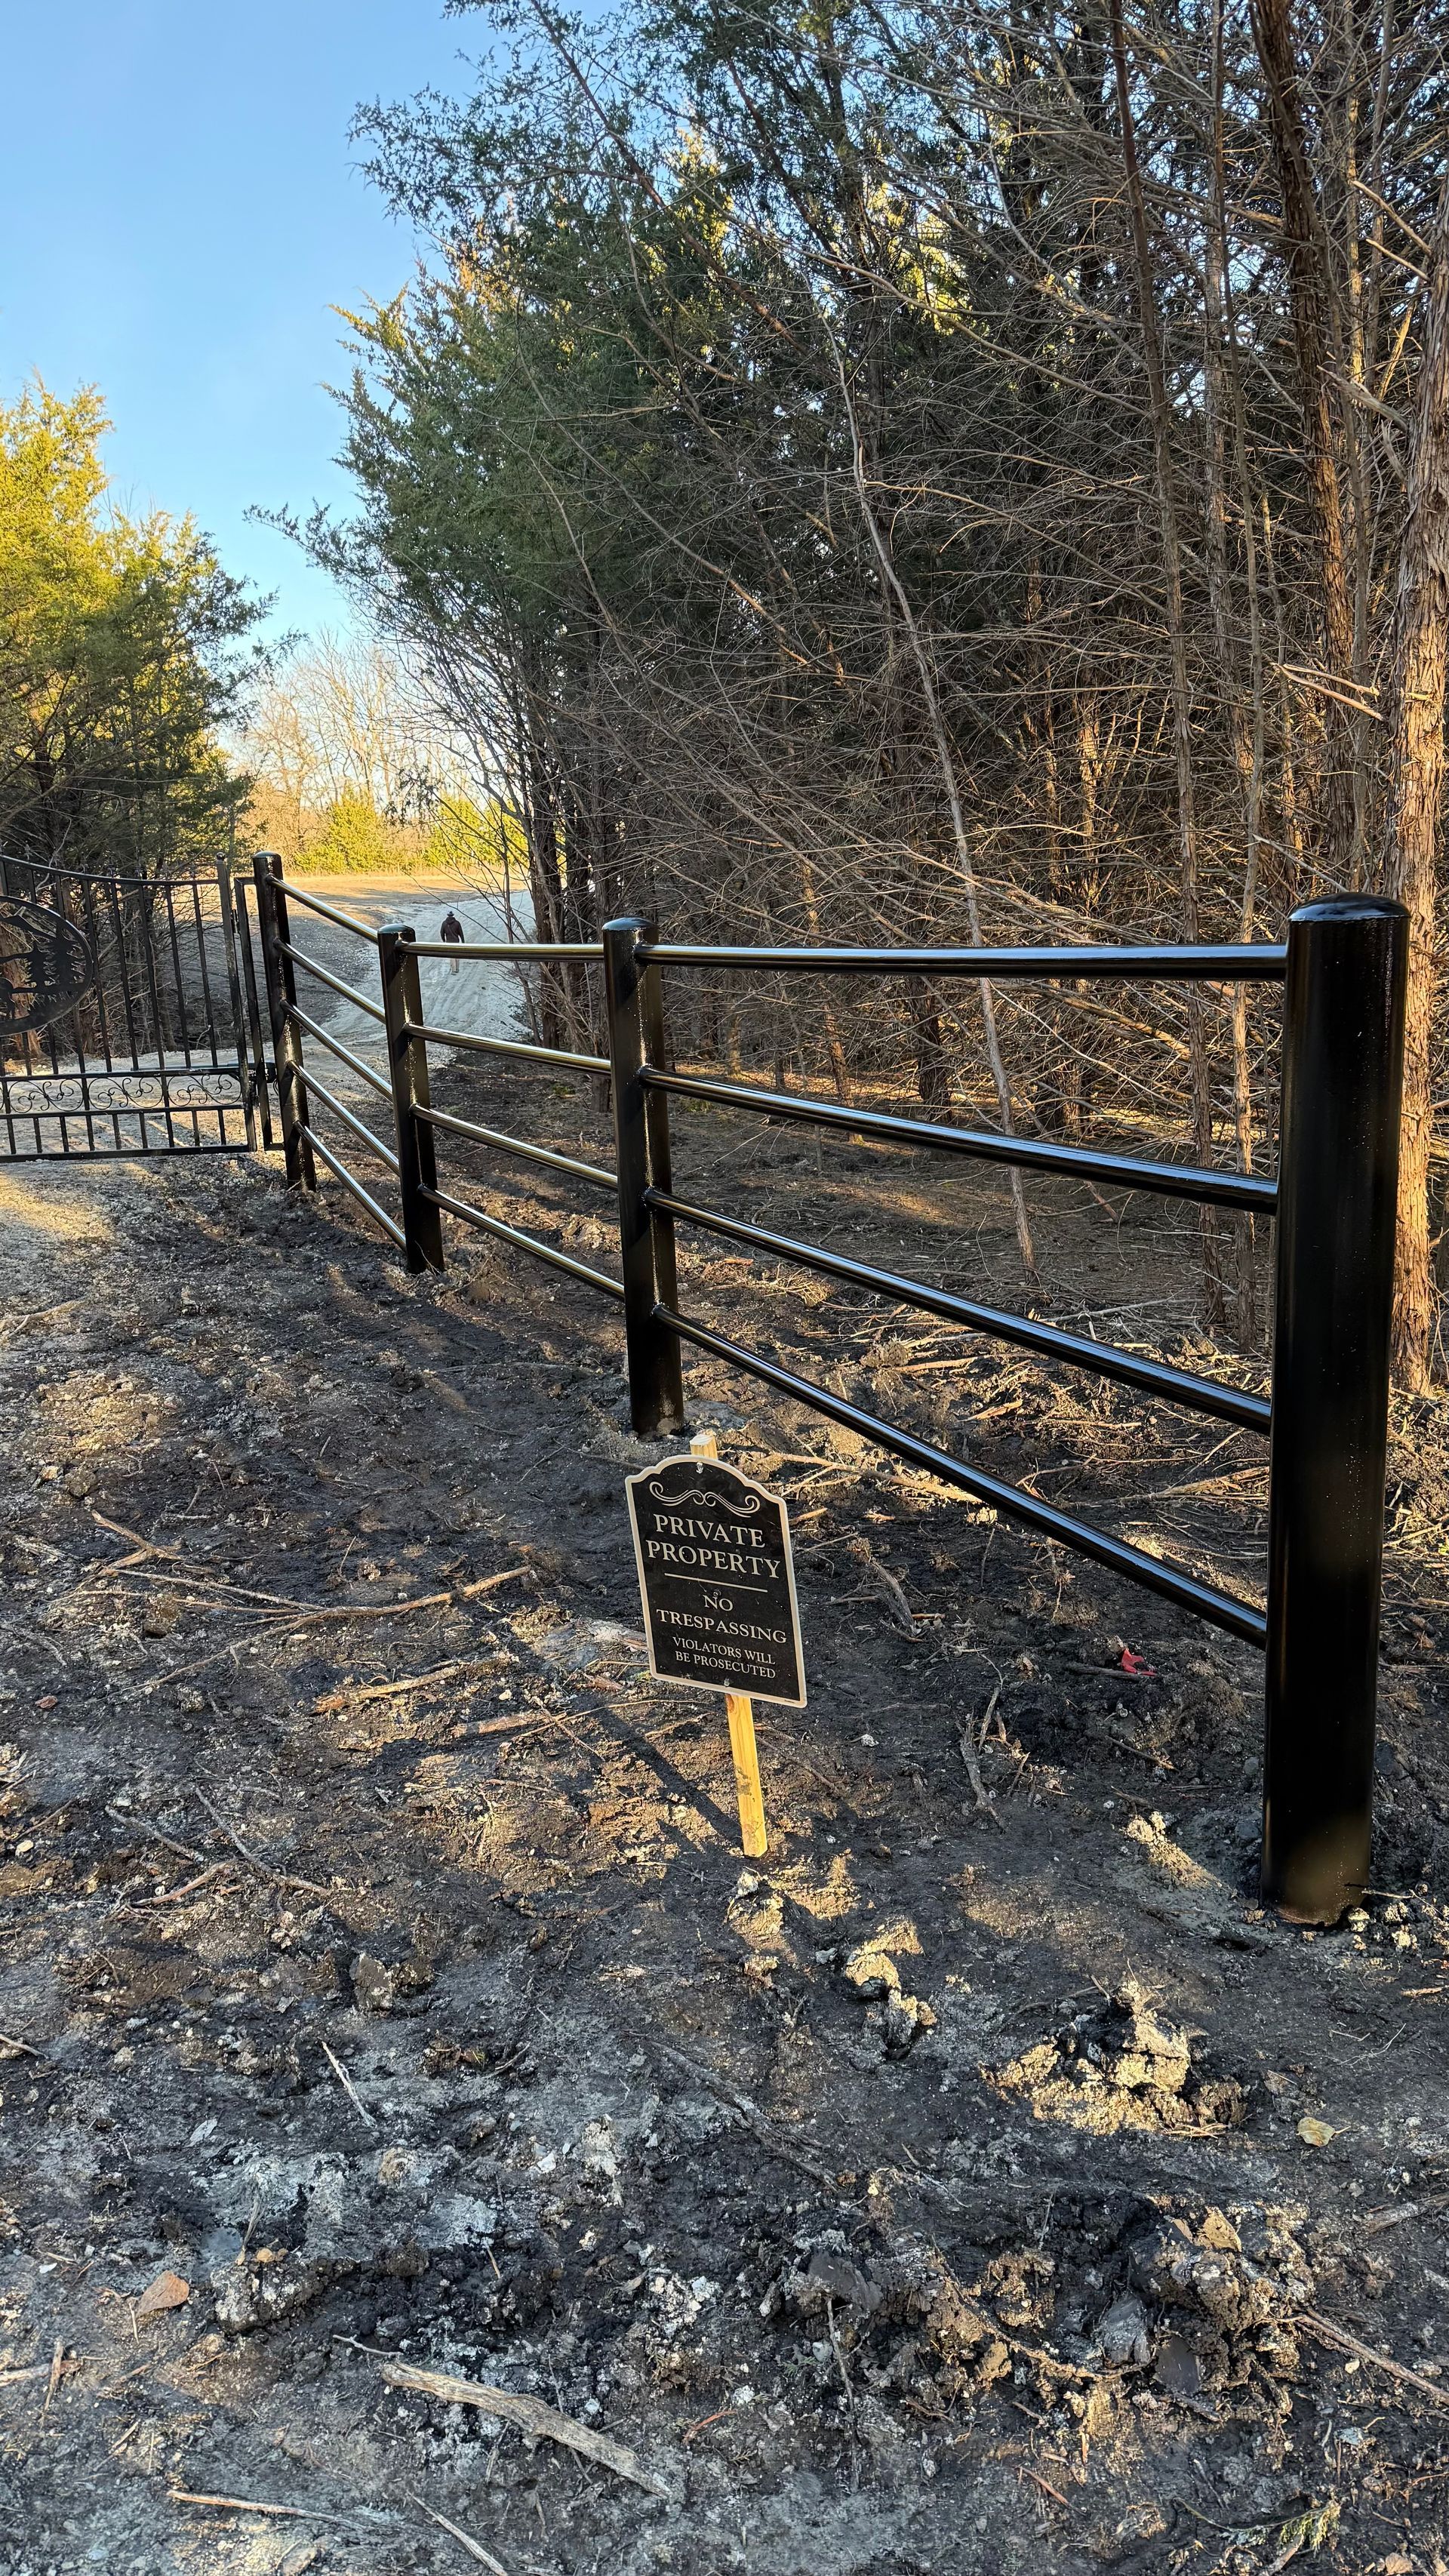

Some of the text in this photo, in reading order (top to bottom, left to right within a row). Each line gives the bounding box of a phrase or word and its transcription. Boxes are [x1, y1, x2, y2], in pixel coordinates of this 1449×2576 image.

[654, 1514, 765, 1548] PRIVATE
[645, 1540, 780, 1578] PROPERTY
[703, 1595, 734, 1611] NO
[656, 1609, 787, 1643] TRESPASSING
[672, 1636, 776, 1665] VIOLATORS WILL
[675, 1651, 776, 1679] BE PROSECUTED
